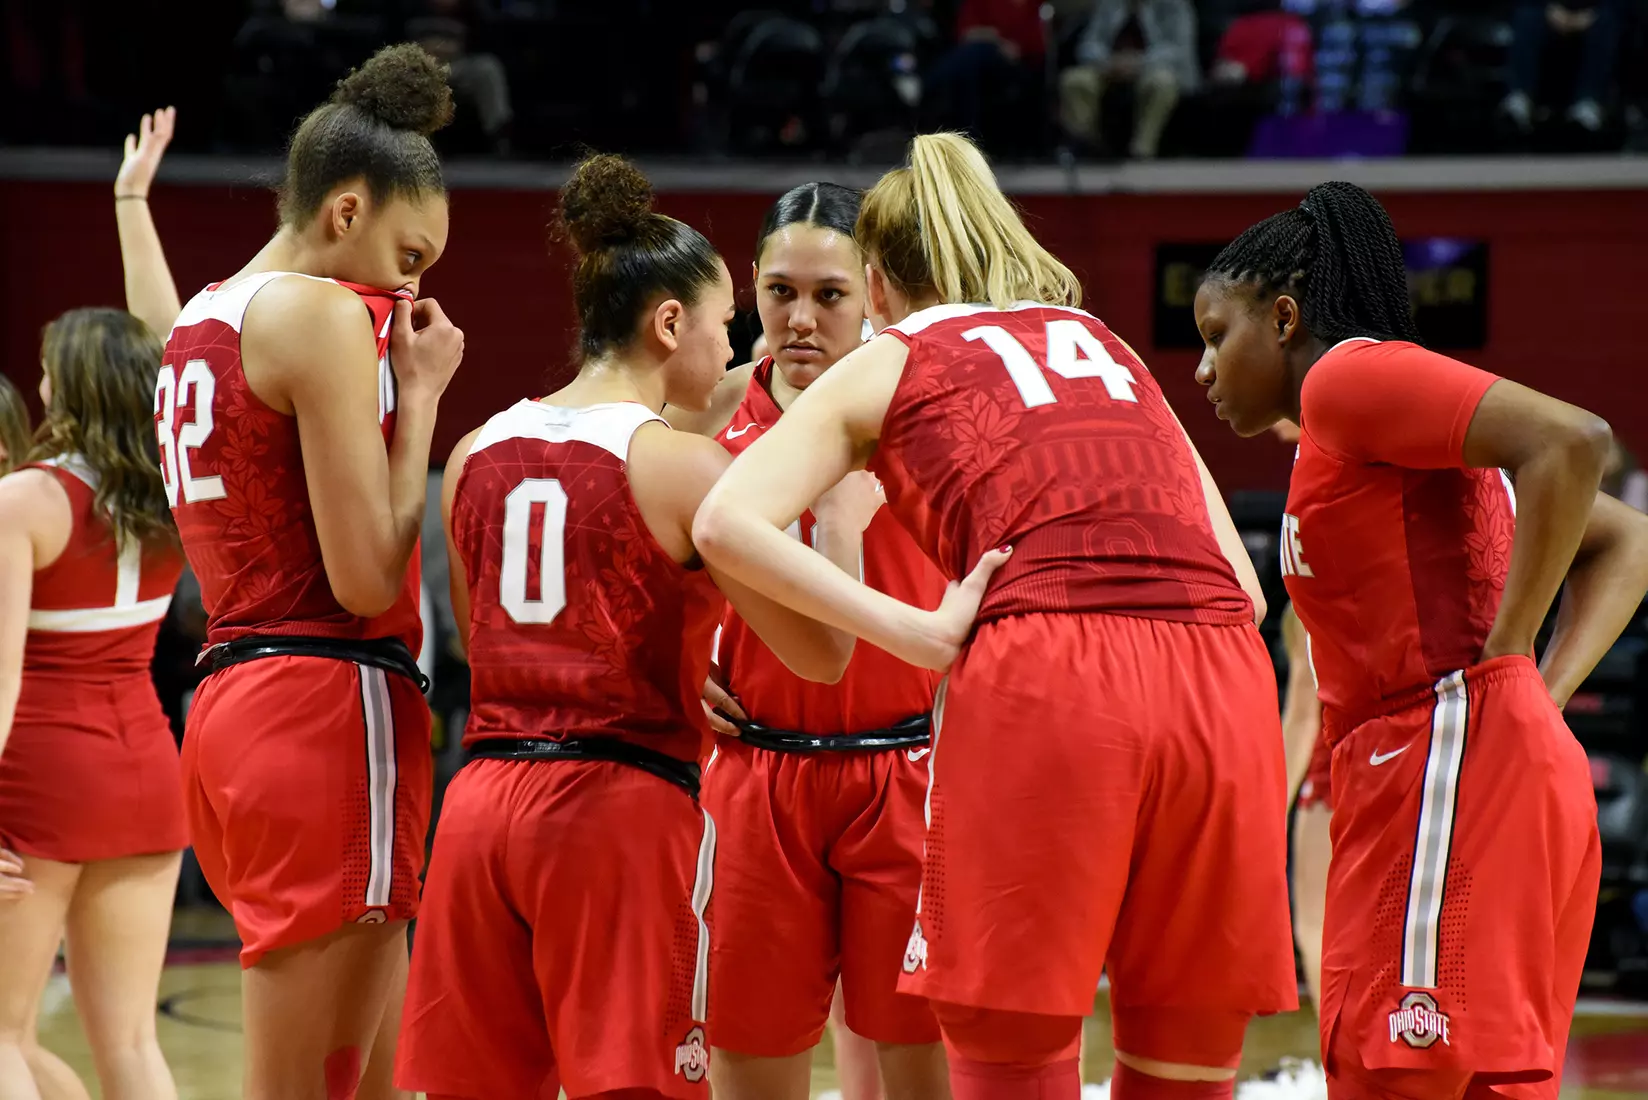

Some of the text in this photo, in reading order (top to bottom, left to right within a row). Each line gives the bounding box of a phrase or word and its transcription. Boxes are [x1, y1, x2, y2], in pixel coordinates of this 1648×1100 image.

[154, 359, 228, 508] 32
[960, 320, 1139, 408] 14
[500, 478, 568, 624] 0
